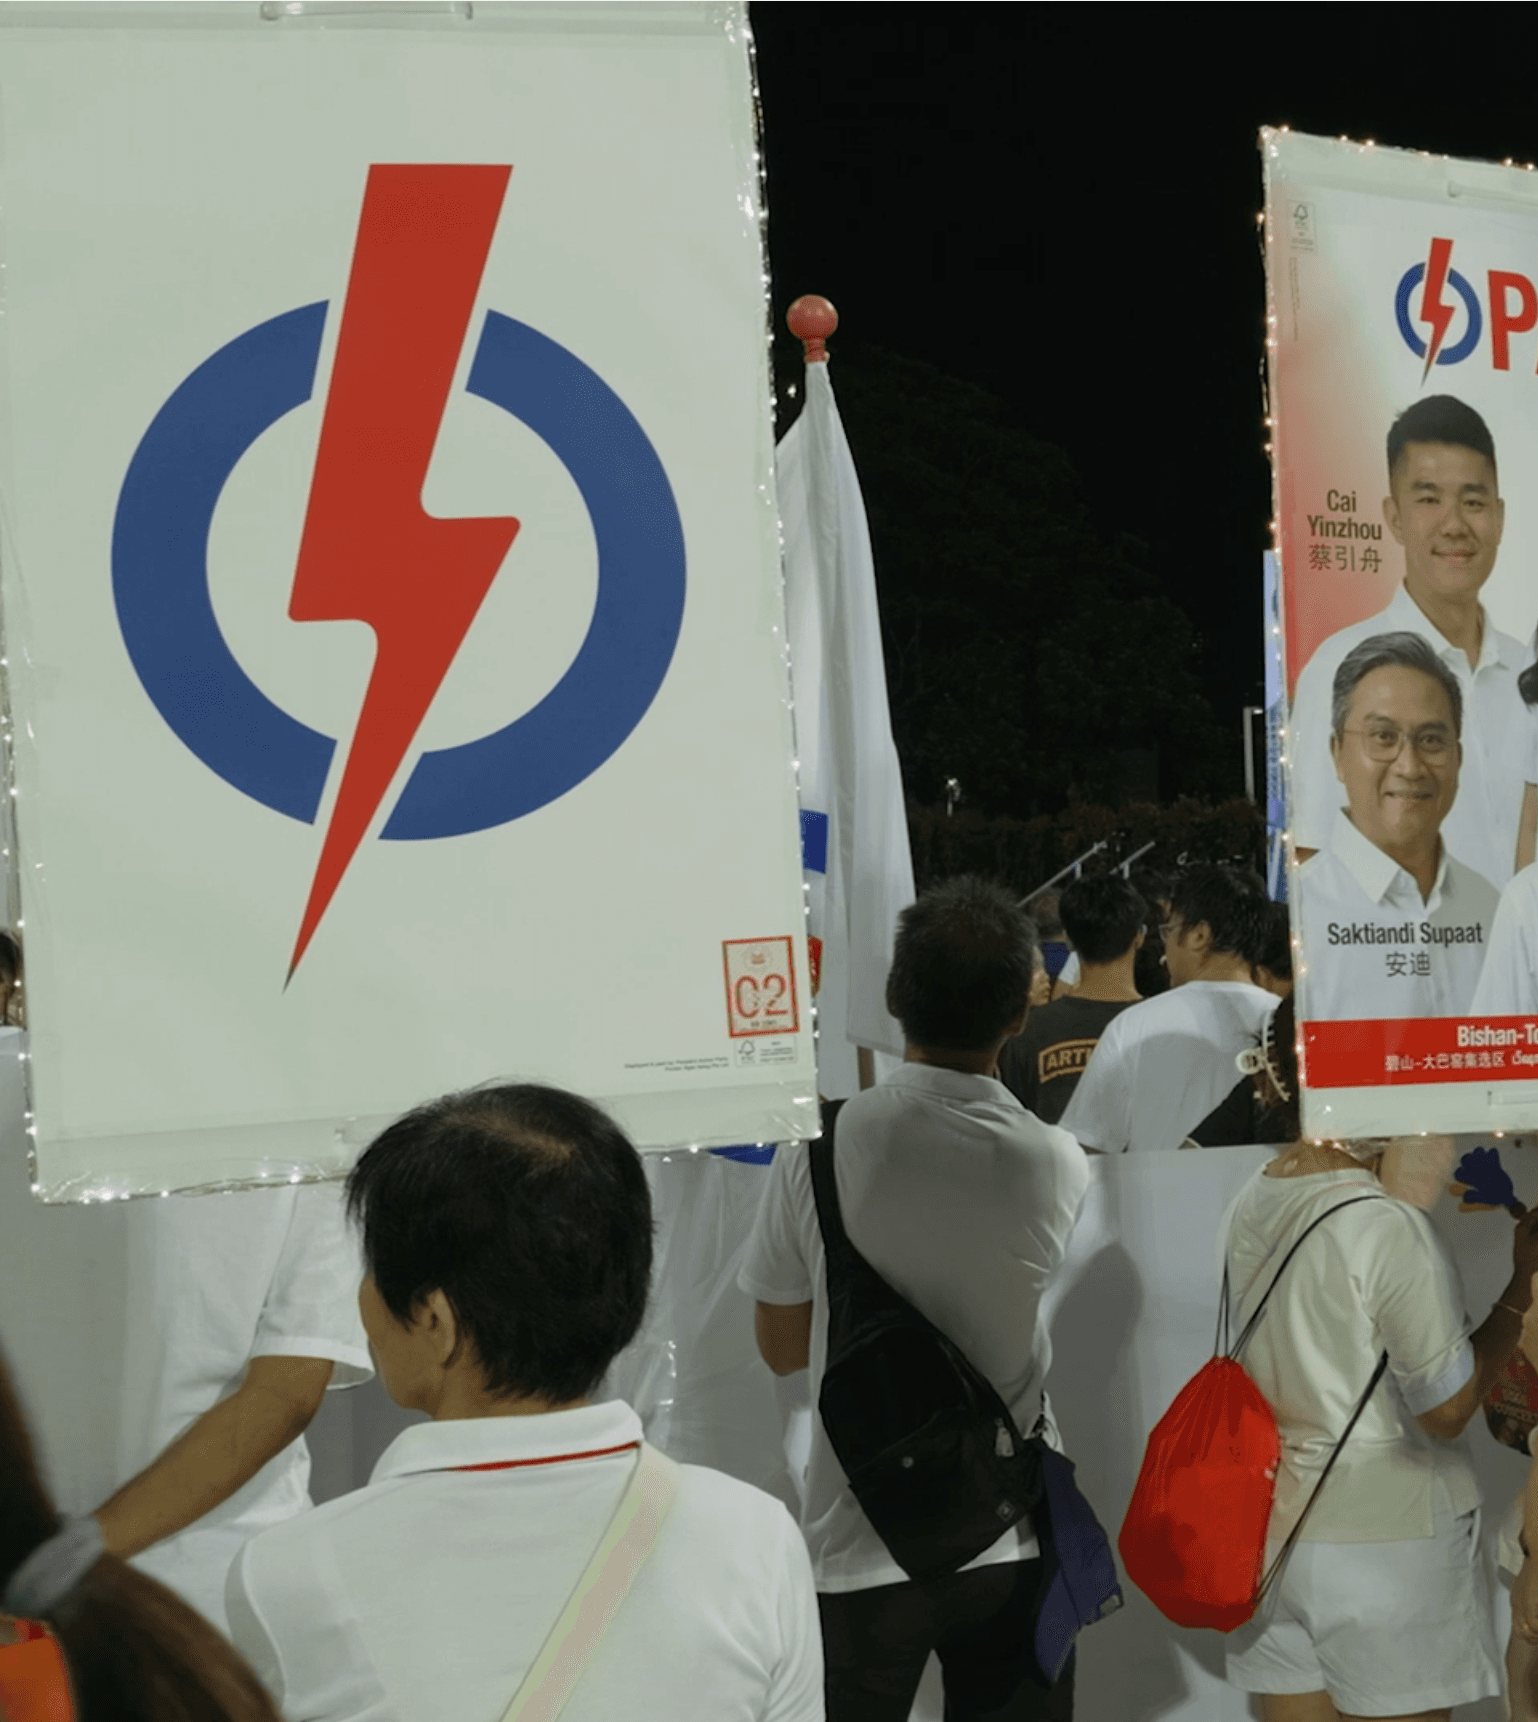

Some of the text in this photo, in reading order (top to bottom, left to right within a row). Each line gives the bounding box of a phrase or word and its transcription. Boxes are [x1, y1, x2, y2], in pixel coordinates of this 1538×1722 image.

[1326, 488, 1357, 513] Cai
[1306, 514, 1383, 541] Yinzhou
[1308, 543, 1383, 574] 蔡引舟
[1327, 921, 1484, 949] Saktiandi Supaat
[1385, 951, 1432, 978] 安迪
